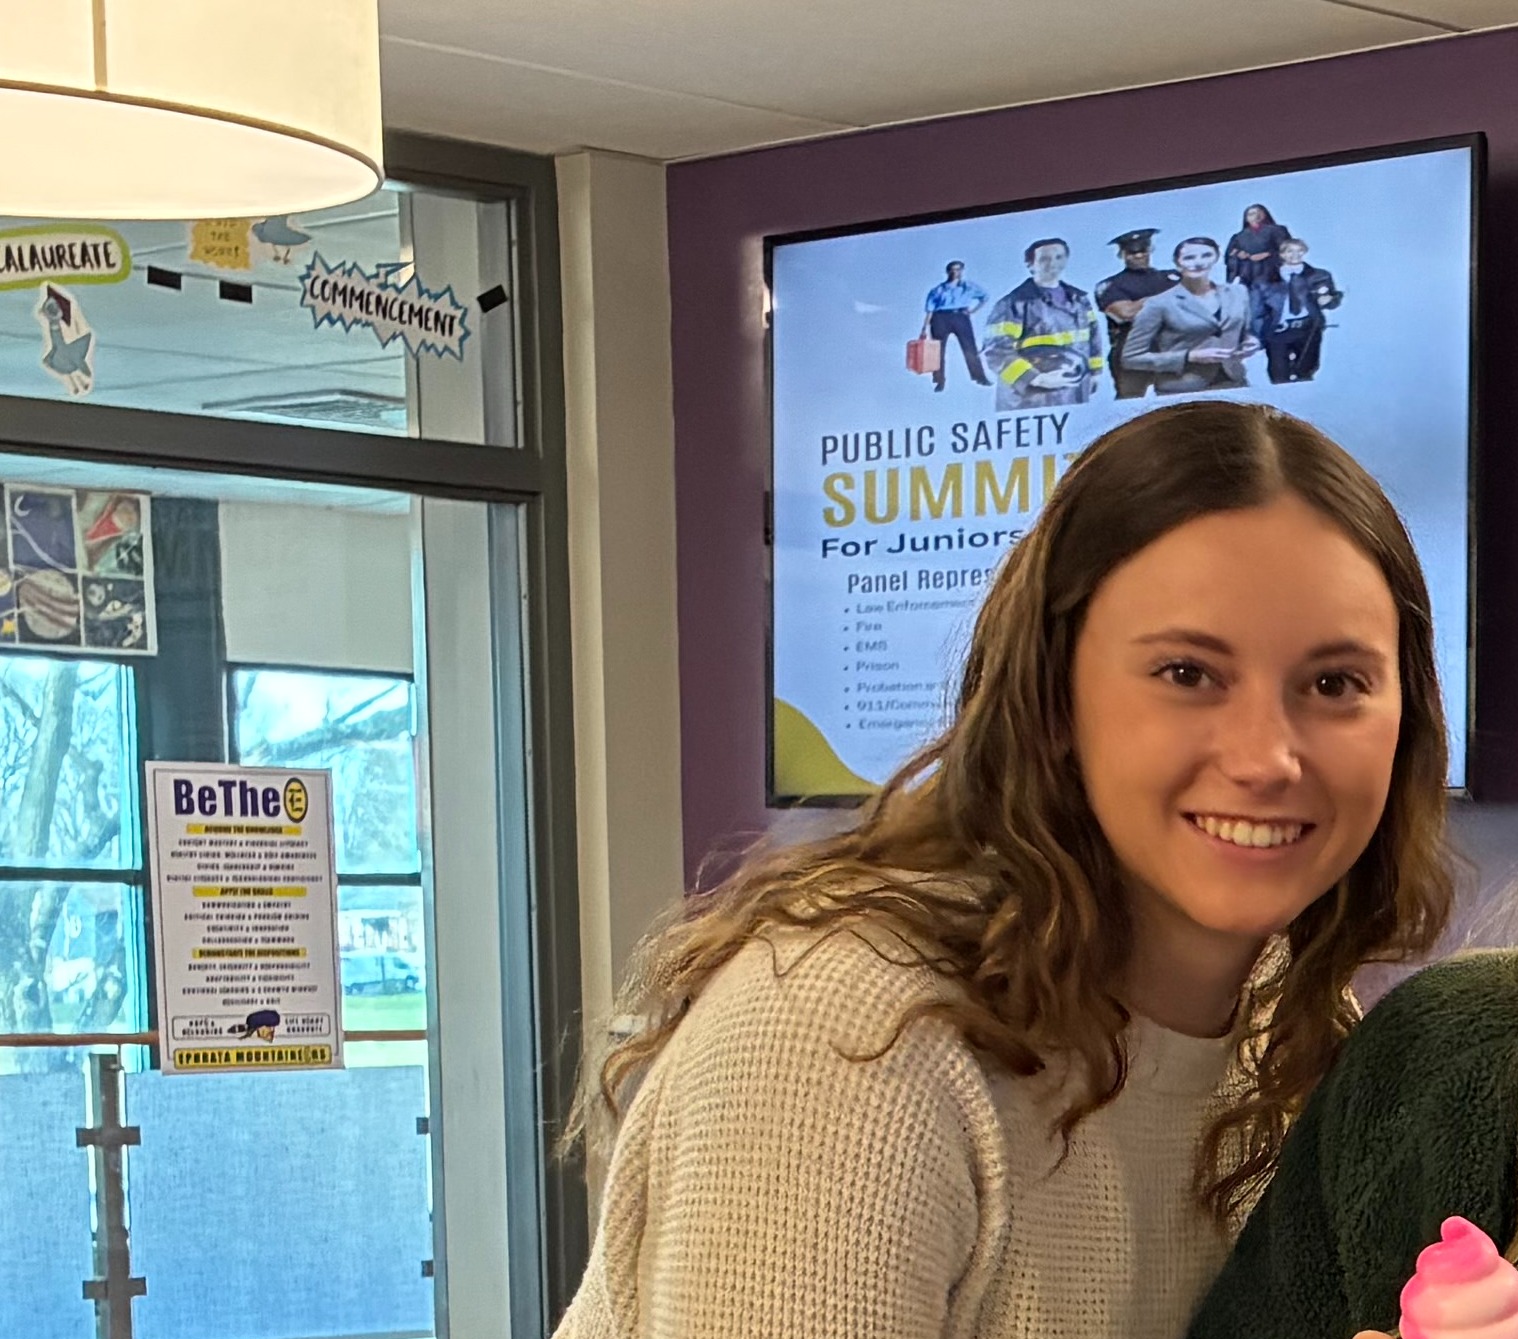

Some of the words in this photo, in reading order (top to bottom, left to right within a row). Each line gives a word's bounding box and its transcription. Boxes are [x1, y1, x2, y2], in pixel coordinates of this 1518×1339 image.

[309, 275, 457, 338] COMMENCEMENT
[821, 425, 936, 466] PUBLIC
[950, 412, 1070, 454] SAFETY
[822, 452, 1078, 528] SUMMI
[821, 538, 878, 558] For
[887, 528, 1025, 554] Juniors
[847, 570, 908, 594] Panel
[855, 659, 900, 672] Prison
[173, 778, 281, 818] BeThe
